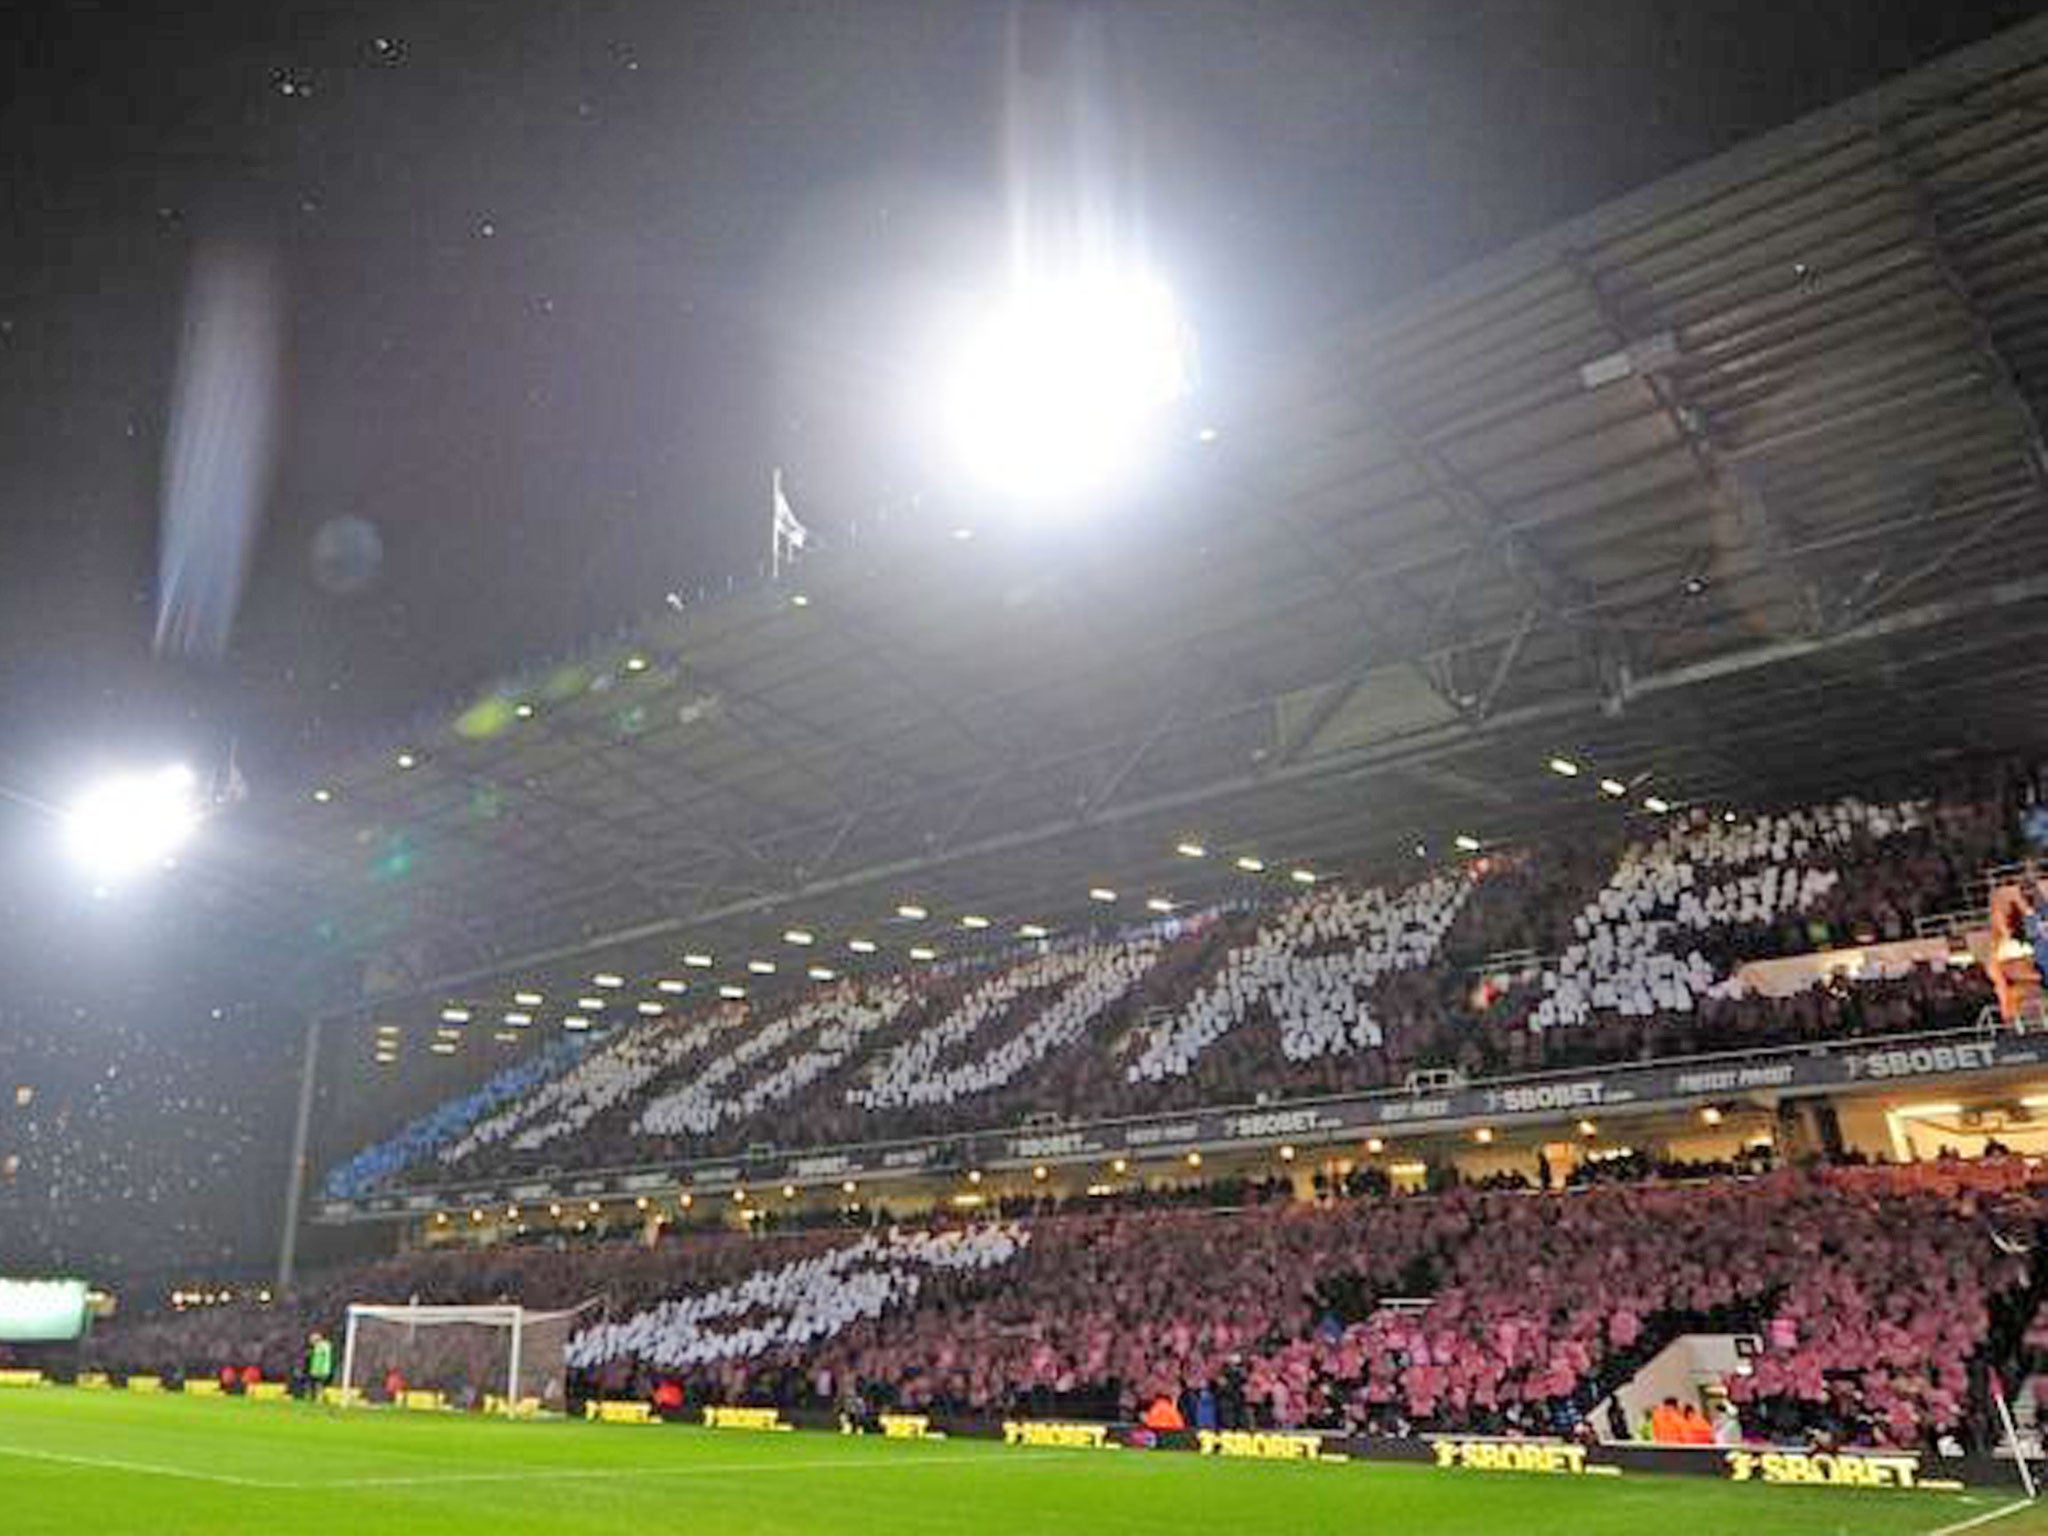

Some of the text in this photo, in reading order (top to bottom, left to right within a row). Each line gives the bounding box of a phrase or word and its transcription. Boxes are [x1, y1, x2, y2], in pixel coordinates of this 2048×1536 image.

[1866, 1042, 1996, 1078] SBOBET
[1502, 1081, 1604, 1112] SBOBET
[1462, 1440, 1587, 1474] SBOBET
[1762, 1451, 1919, 1488] SBOBET
